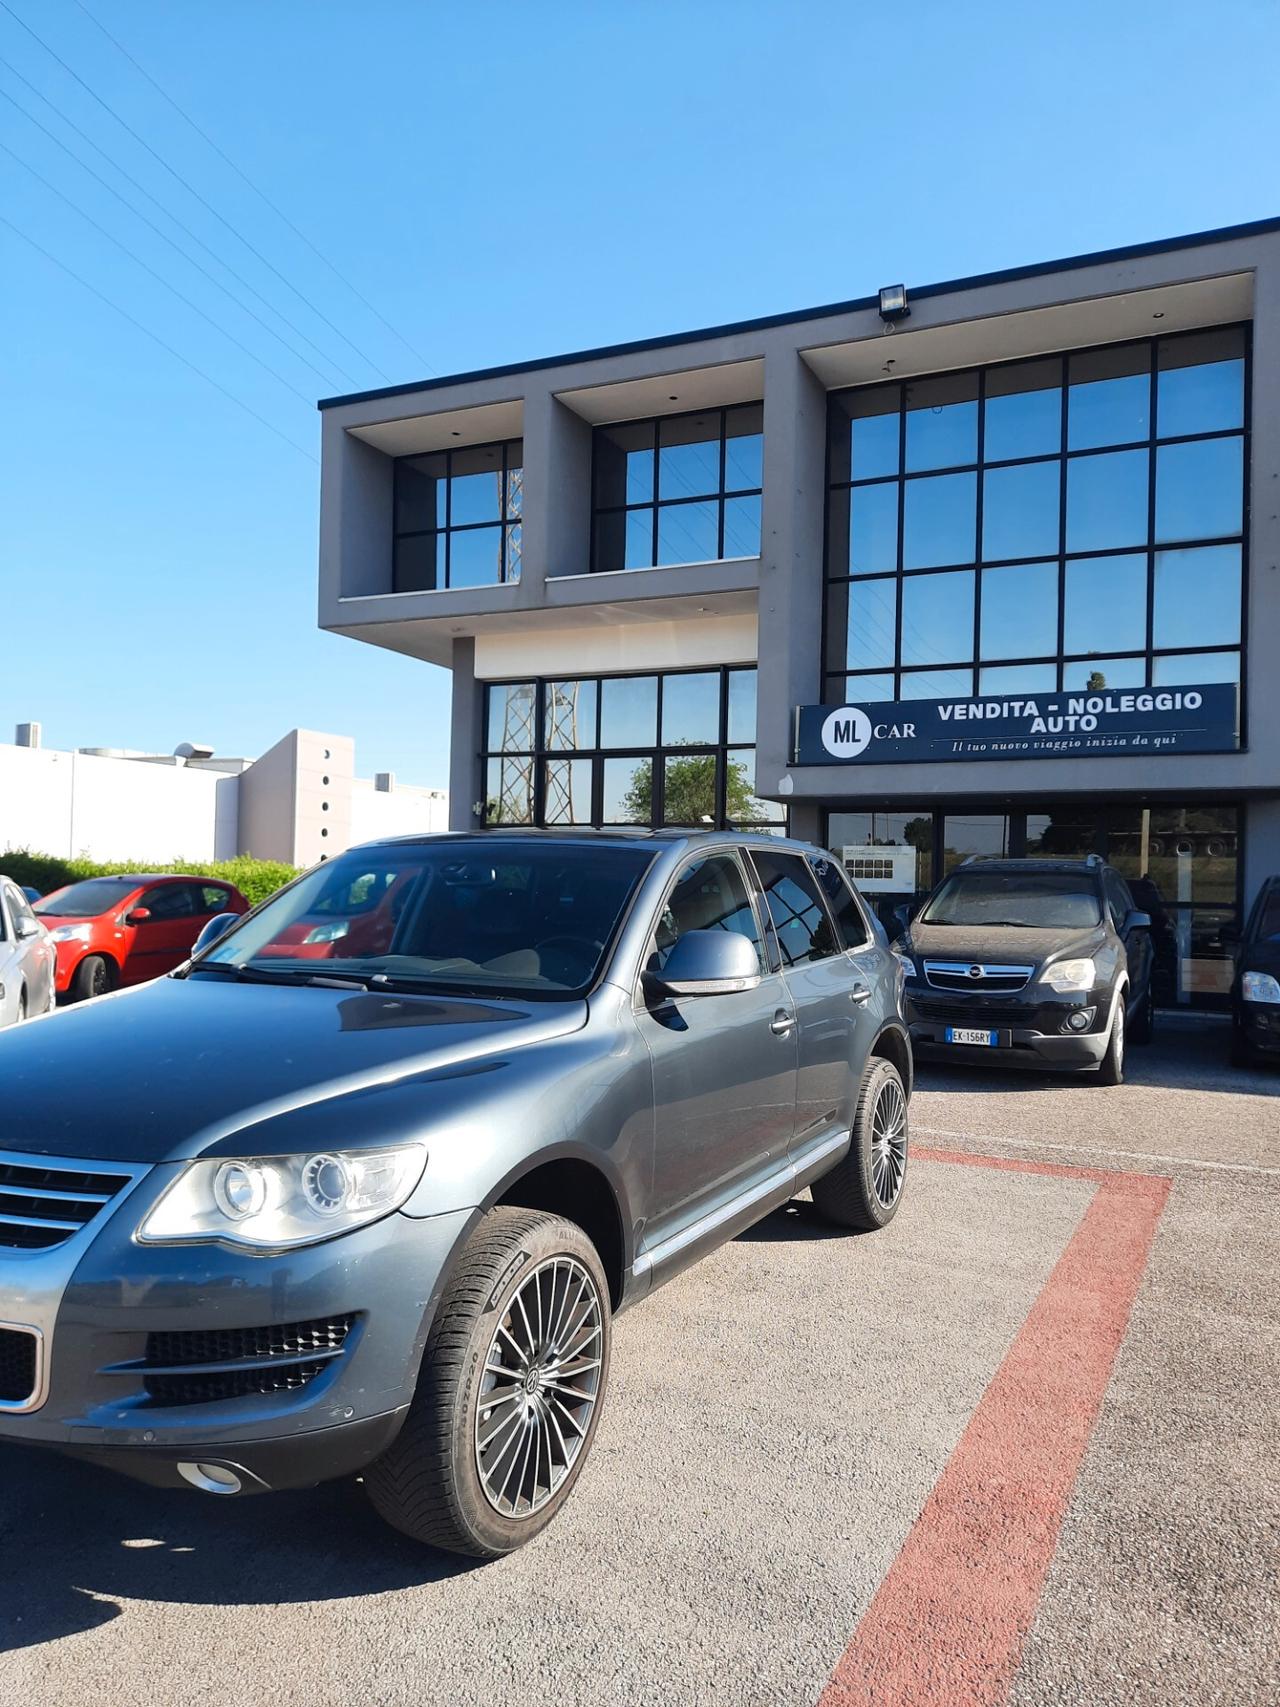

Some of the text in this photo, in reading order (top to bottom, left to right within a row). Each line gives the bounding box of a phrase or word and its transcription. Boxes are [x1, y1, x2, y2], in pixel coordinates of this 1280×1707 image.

[938, 701, 1040, 720] VENDITA
[1068, 692, 1203, 714] NOLEGGIO
[834, 720, 917, 743] ML CAR
[1030, 714, 1098, 733] AUTO
[952, 733, 1177, 751] Il tuo nuovo viaggio inizia da qui
